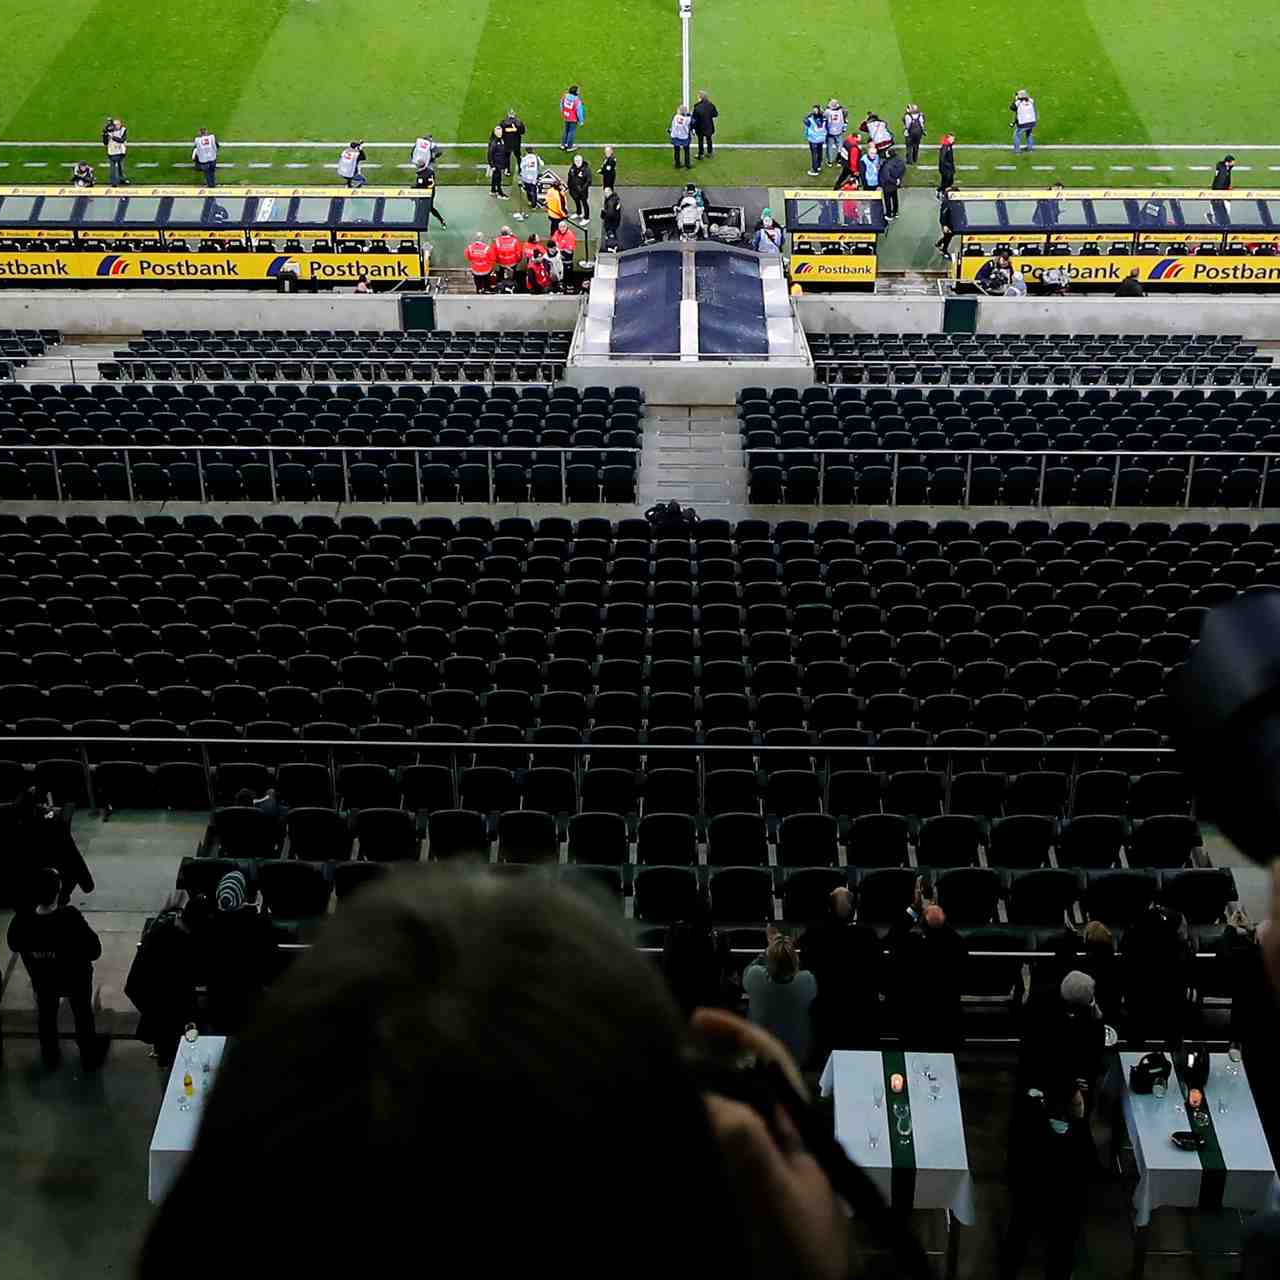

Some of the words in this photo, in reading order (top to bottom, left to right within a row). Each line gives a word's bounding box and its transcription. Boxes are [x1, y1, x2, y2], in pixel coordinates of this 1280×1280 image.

[138, 258, 240, 279] Postbank
[309, 259, 410, 280] Postbank
[817, 263, 874, 278] Postbank
